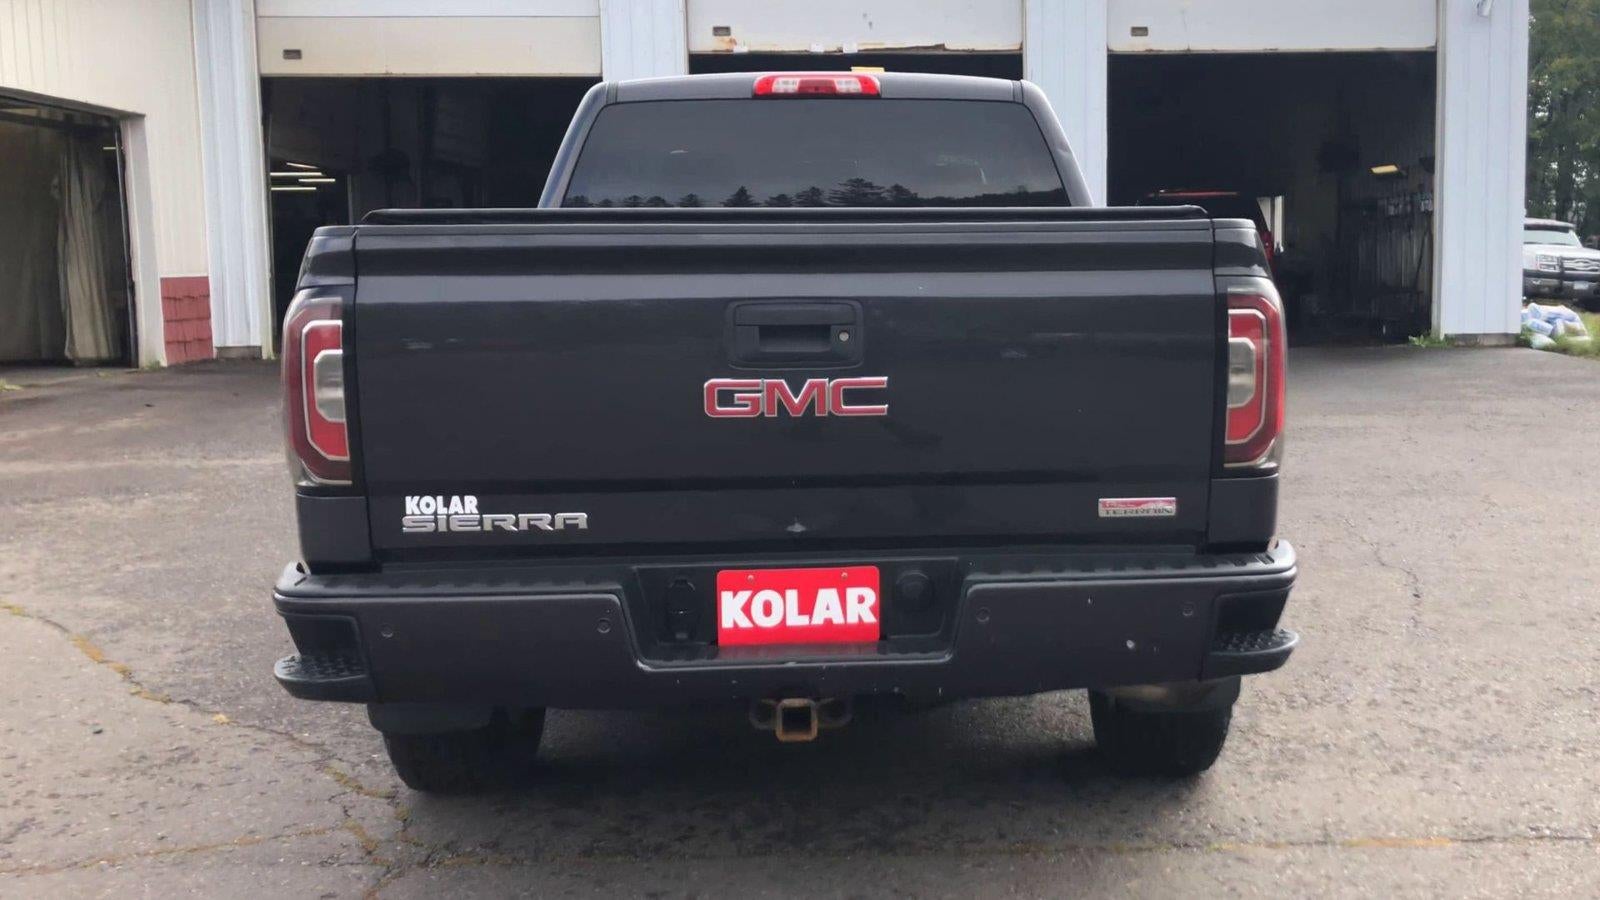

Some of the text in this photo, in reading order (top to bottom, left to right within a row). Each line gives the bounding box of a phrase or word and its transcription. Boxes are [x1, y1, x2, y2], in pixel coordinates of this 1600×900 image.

[704, 376, 888, 417] GMC
[405, 495, 479, 515] KOLAR
[402, 512, 588, 533] SIERRA
[720, 587, 877, 628] KOLAR
